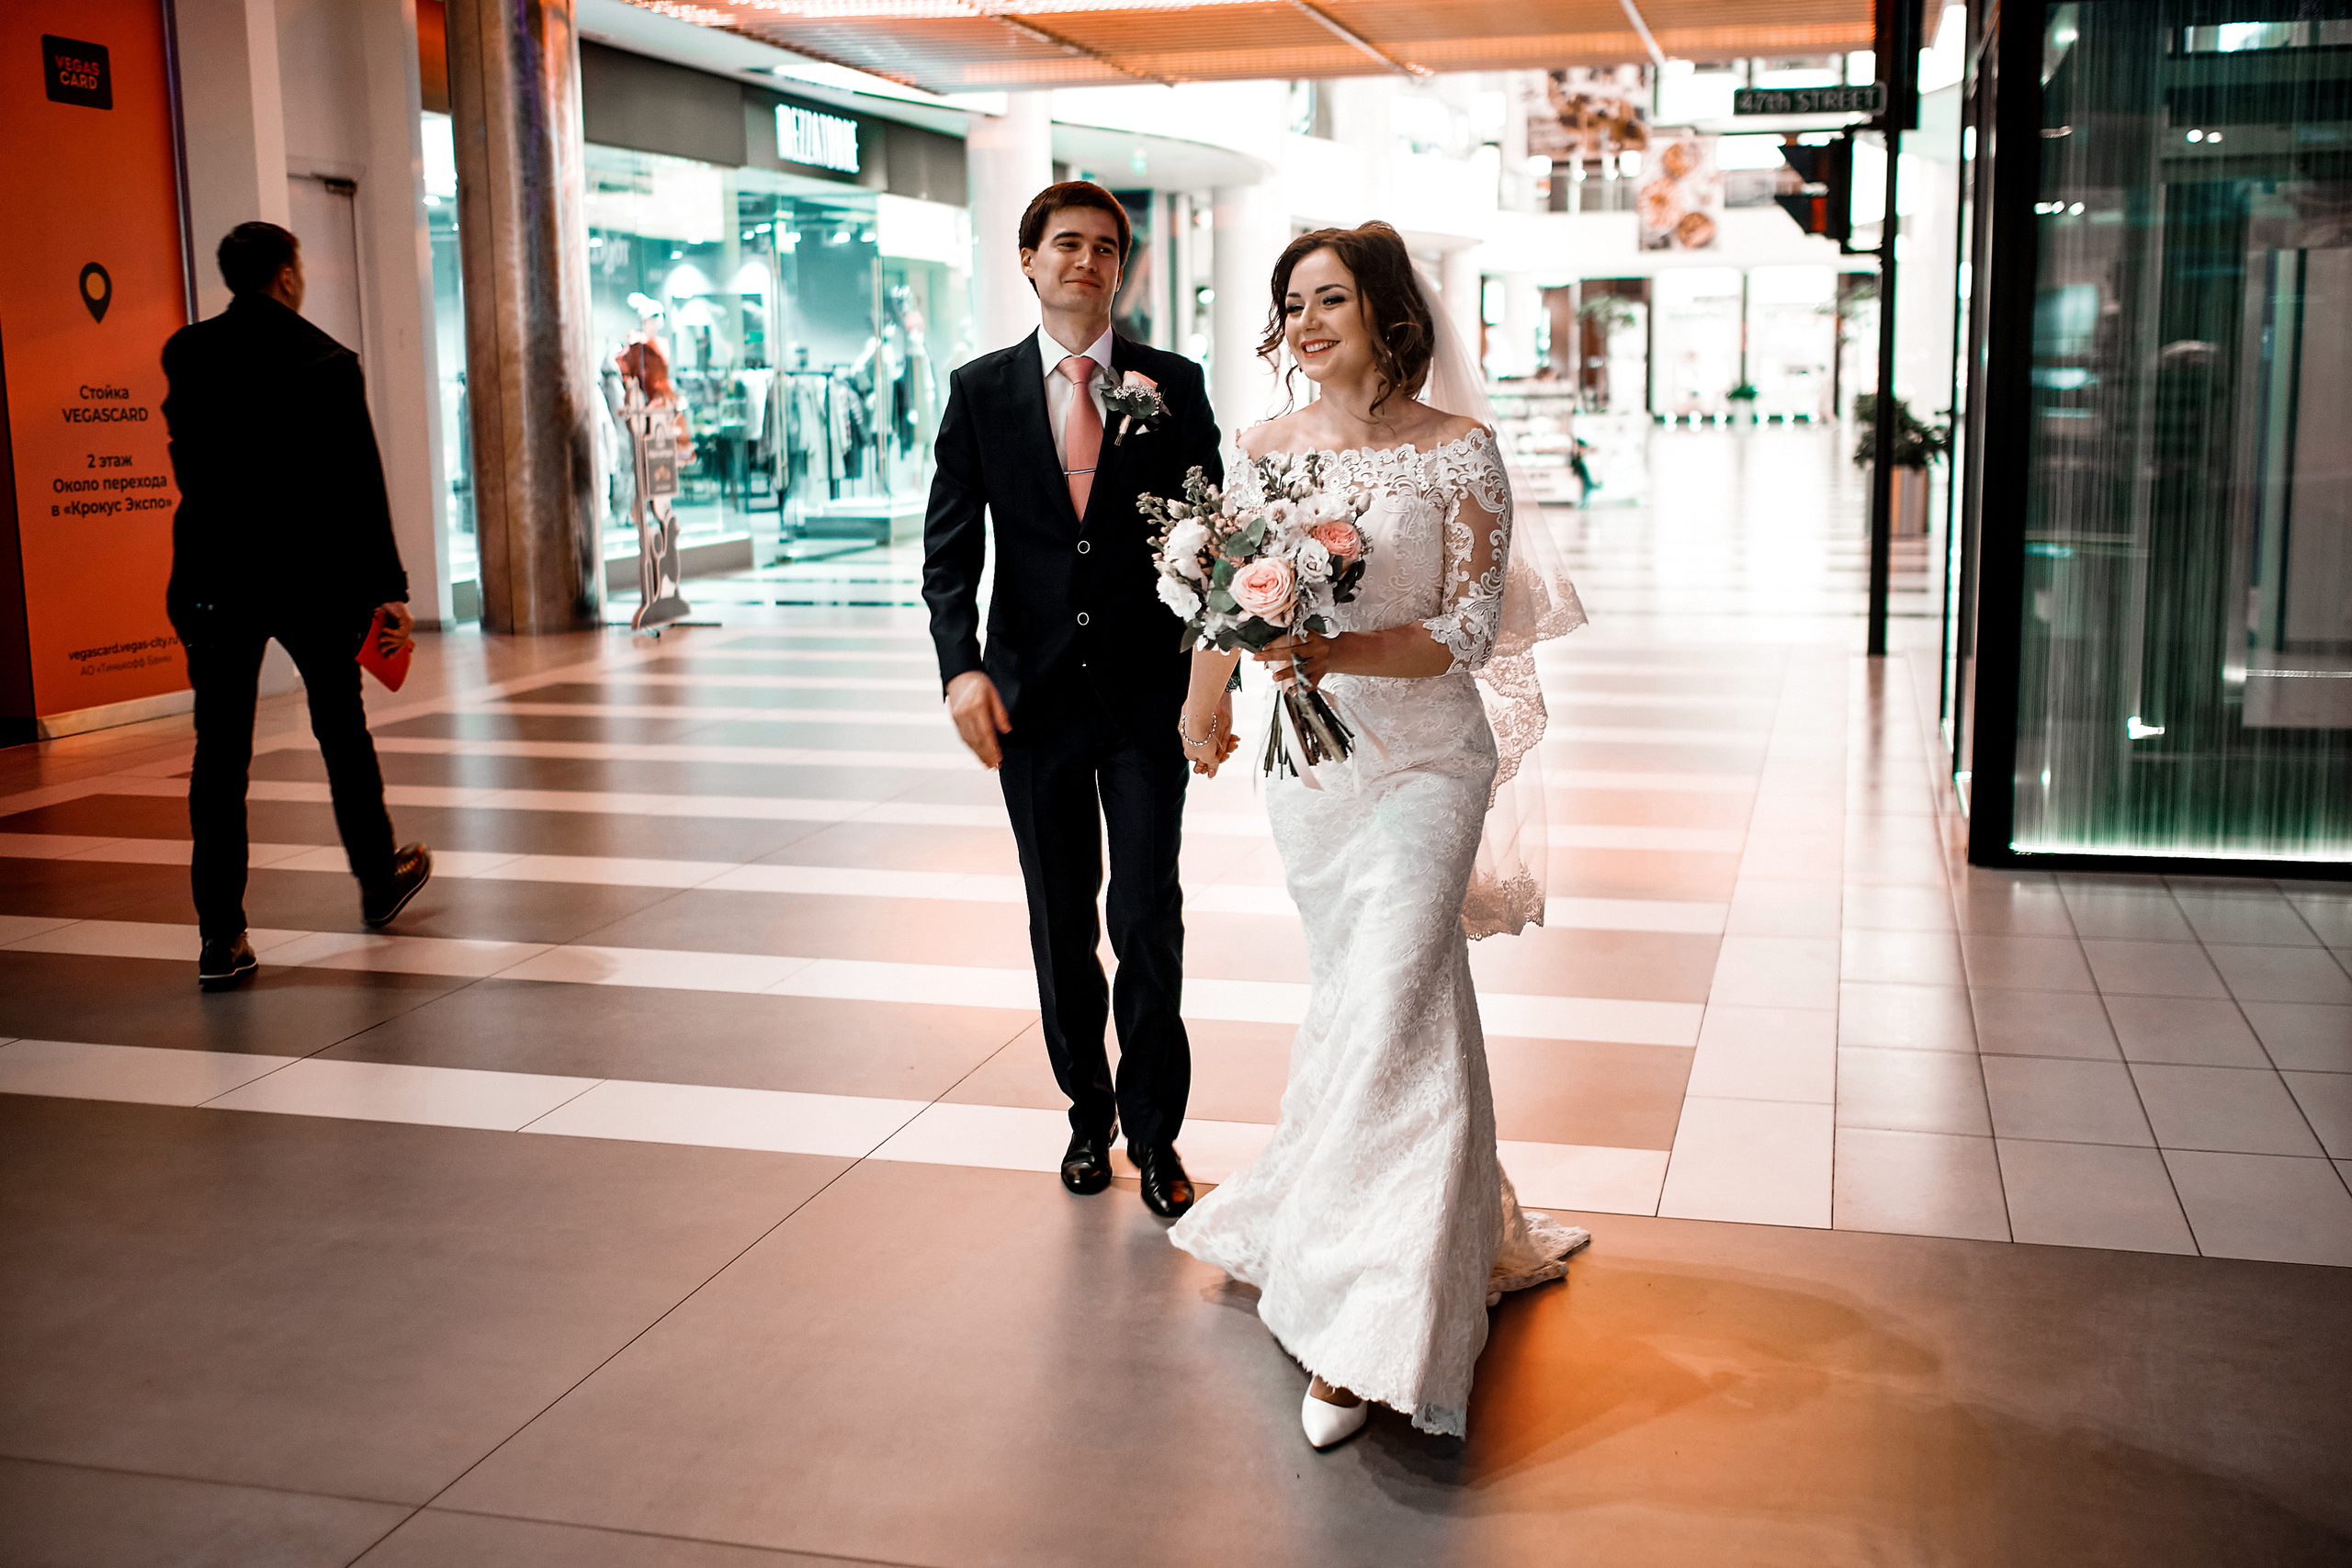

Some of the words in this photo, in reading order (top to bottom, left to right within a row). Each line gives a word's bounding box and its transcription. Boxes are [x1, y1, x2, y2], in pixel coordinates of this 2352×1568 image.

[55, 55, 100, 76] VEGAS
[60, 72, 98, 90] CARD
[1737, 93, 1791, 112] 47th
[1797, 90, 1876, 111] STREET
[79, 385, 130, 400] Стойка
[62, 407, 149, 423] VEGASCARD
[87, 455, 96, 468] 2
[99, 455, 133, 468] этаж
[52, 479, 99, 492] Около
[103, 475, 167, 492] перехода
[51, 505, 60, 516] в
[63, 500, 121, 518] «Крокус
[125, 497, 173, 512] Экспо»
